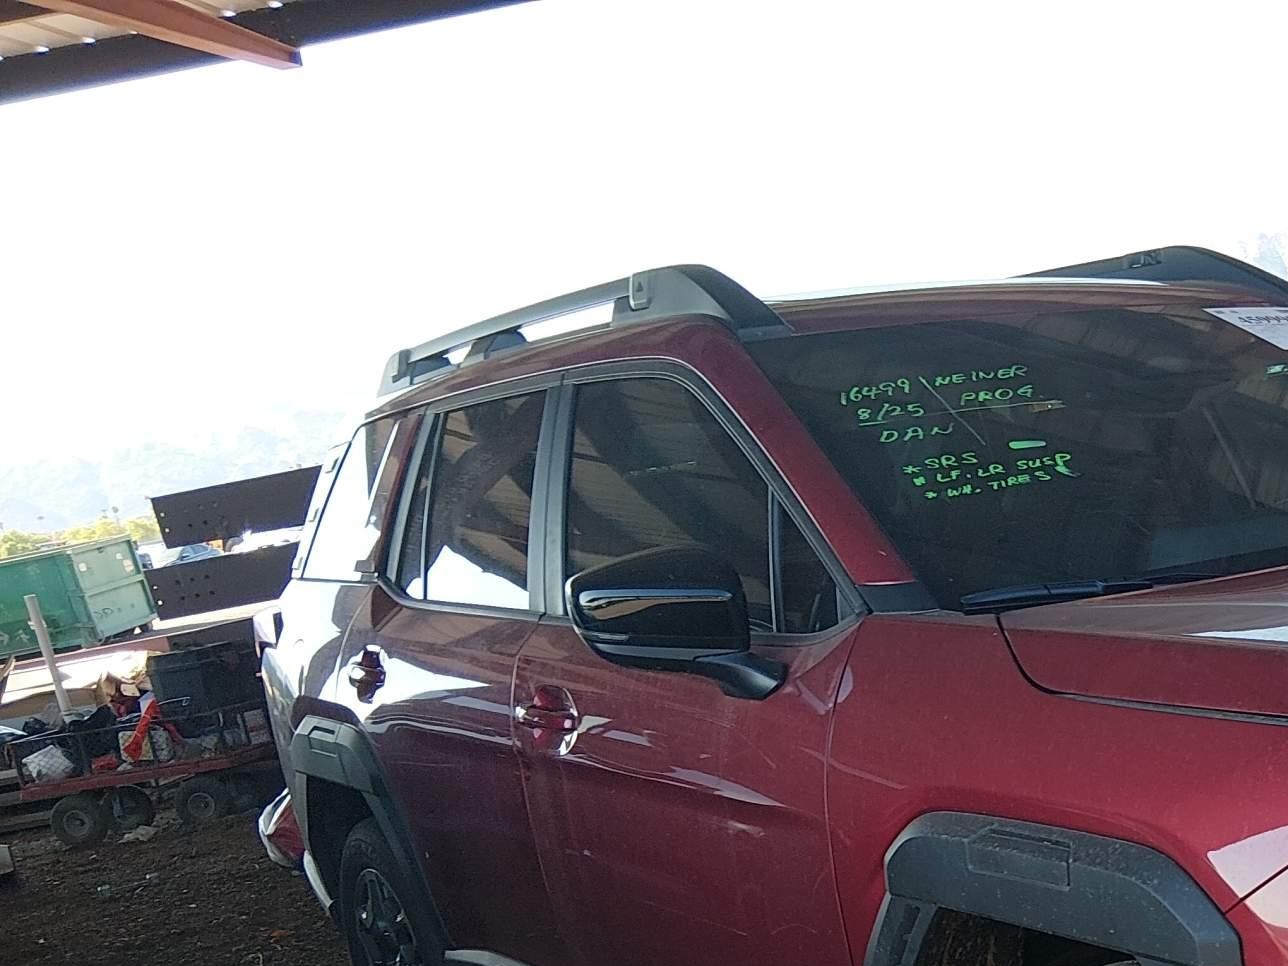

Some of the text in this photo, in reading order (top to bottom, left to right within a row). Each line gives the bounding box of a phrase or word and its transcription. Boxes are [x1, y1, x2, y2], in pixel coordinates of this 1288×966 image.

[840, 378, 911, 405] 16499
[879, 423, 955, 443] DAN
[987, 470, 1052, 490] TIRES
